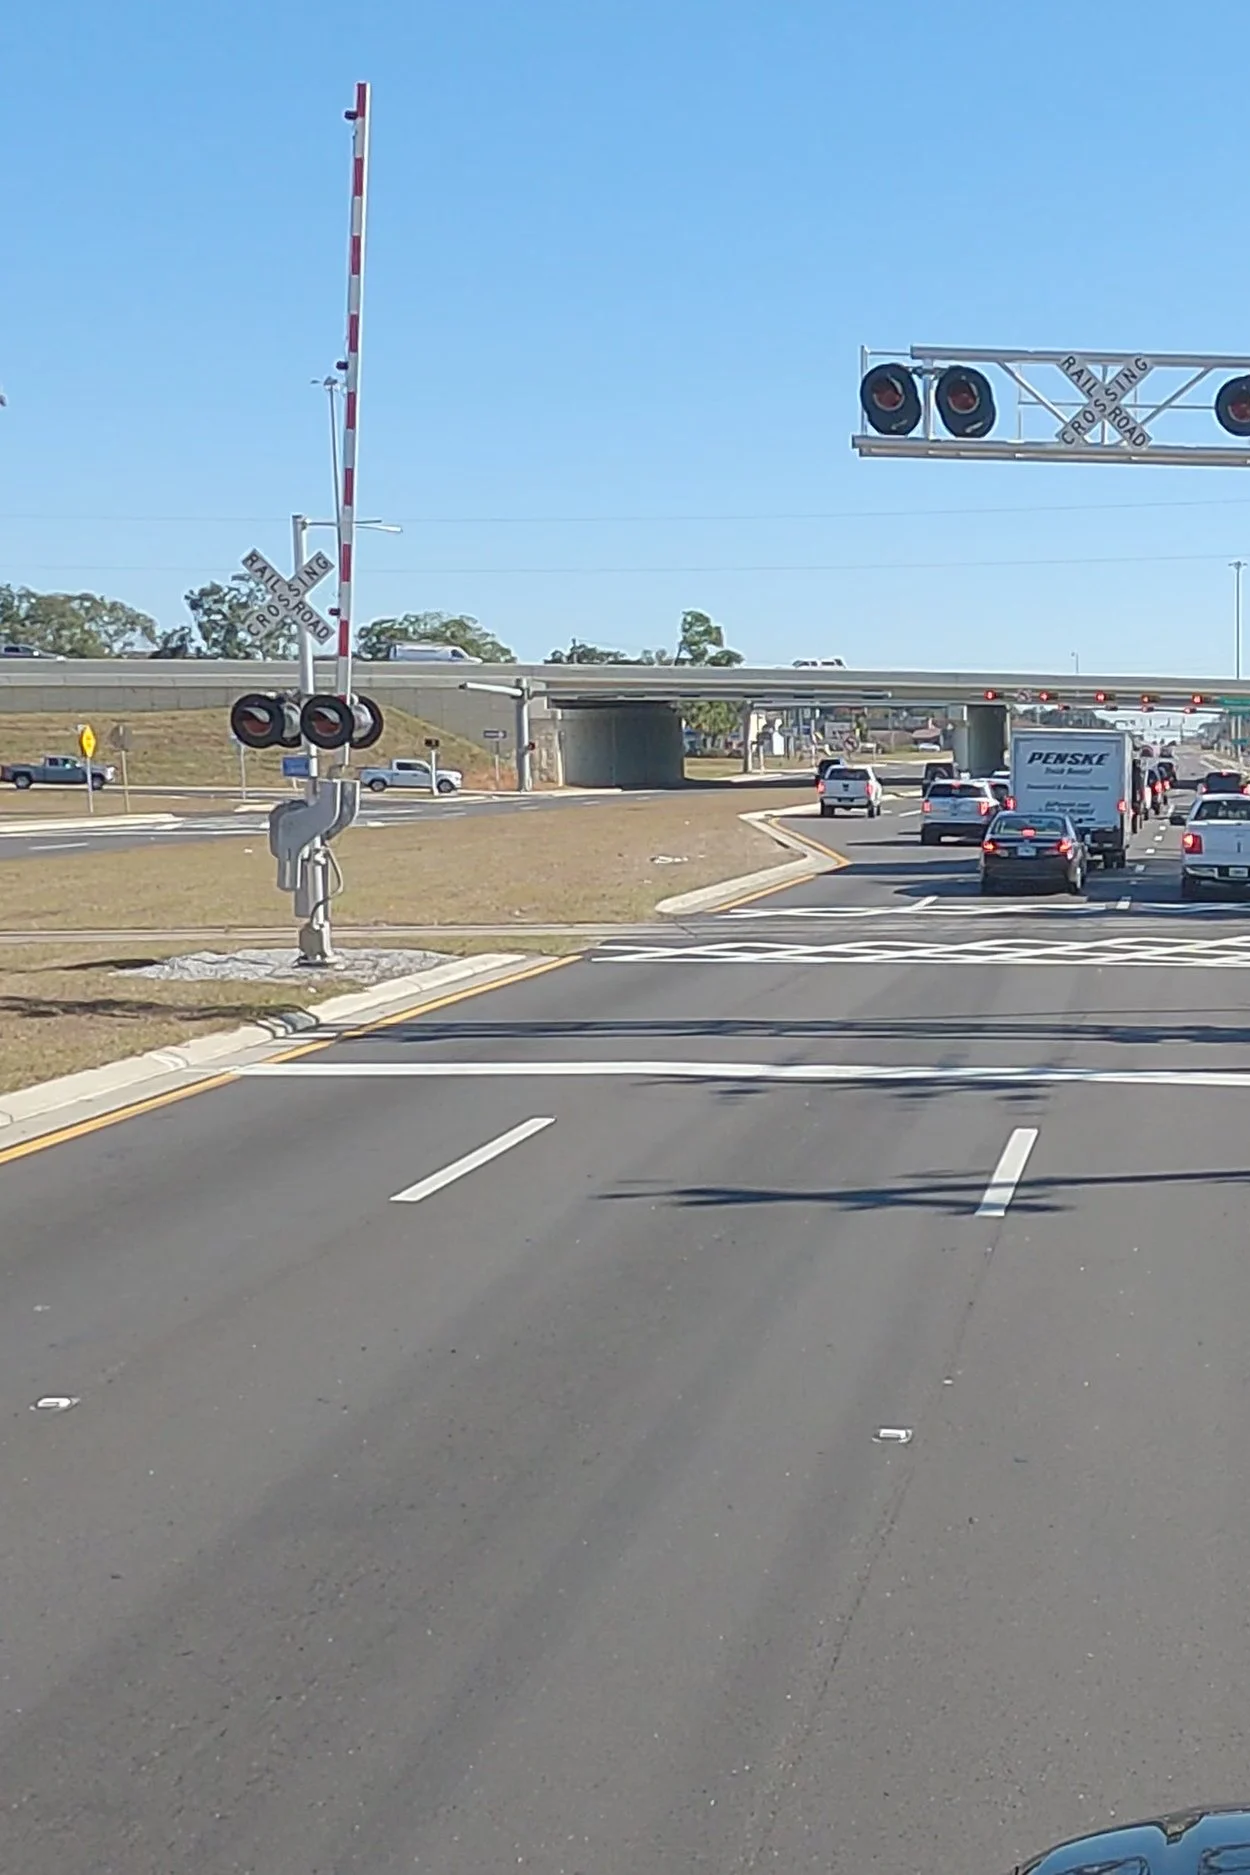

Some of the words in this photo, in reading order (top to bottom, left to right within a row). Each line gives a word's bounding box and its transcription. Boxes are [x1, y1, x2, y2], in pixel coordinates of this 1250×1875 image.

[1061, 357, 1148, 445] CROSSING
[246, 556, 329, 636] CROSSING
[1027, 752, 1111, 766] PENSKE
